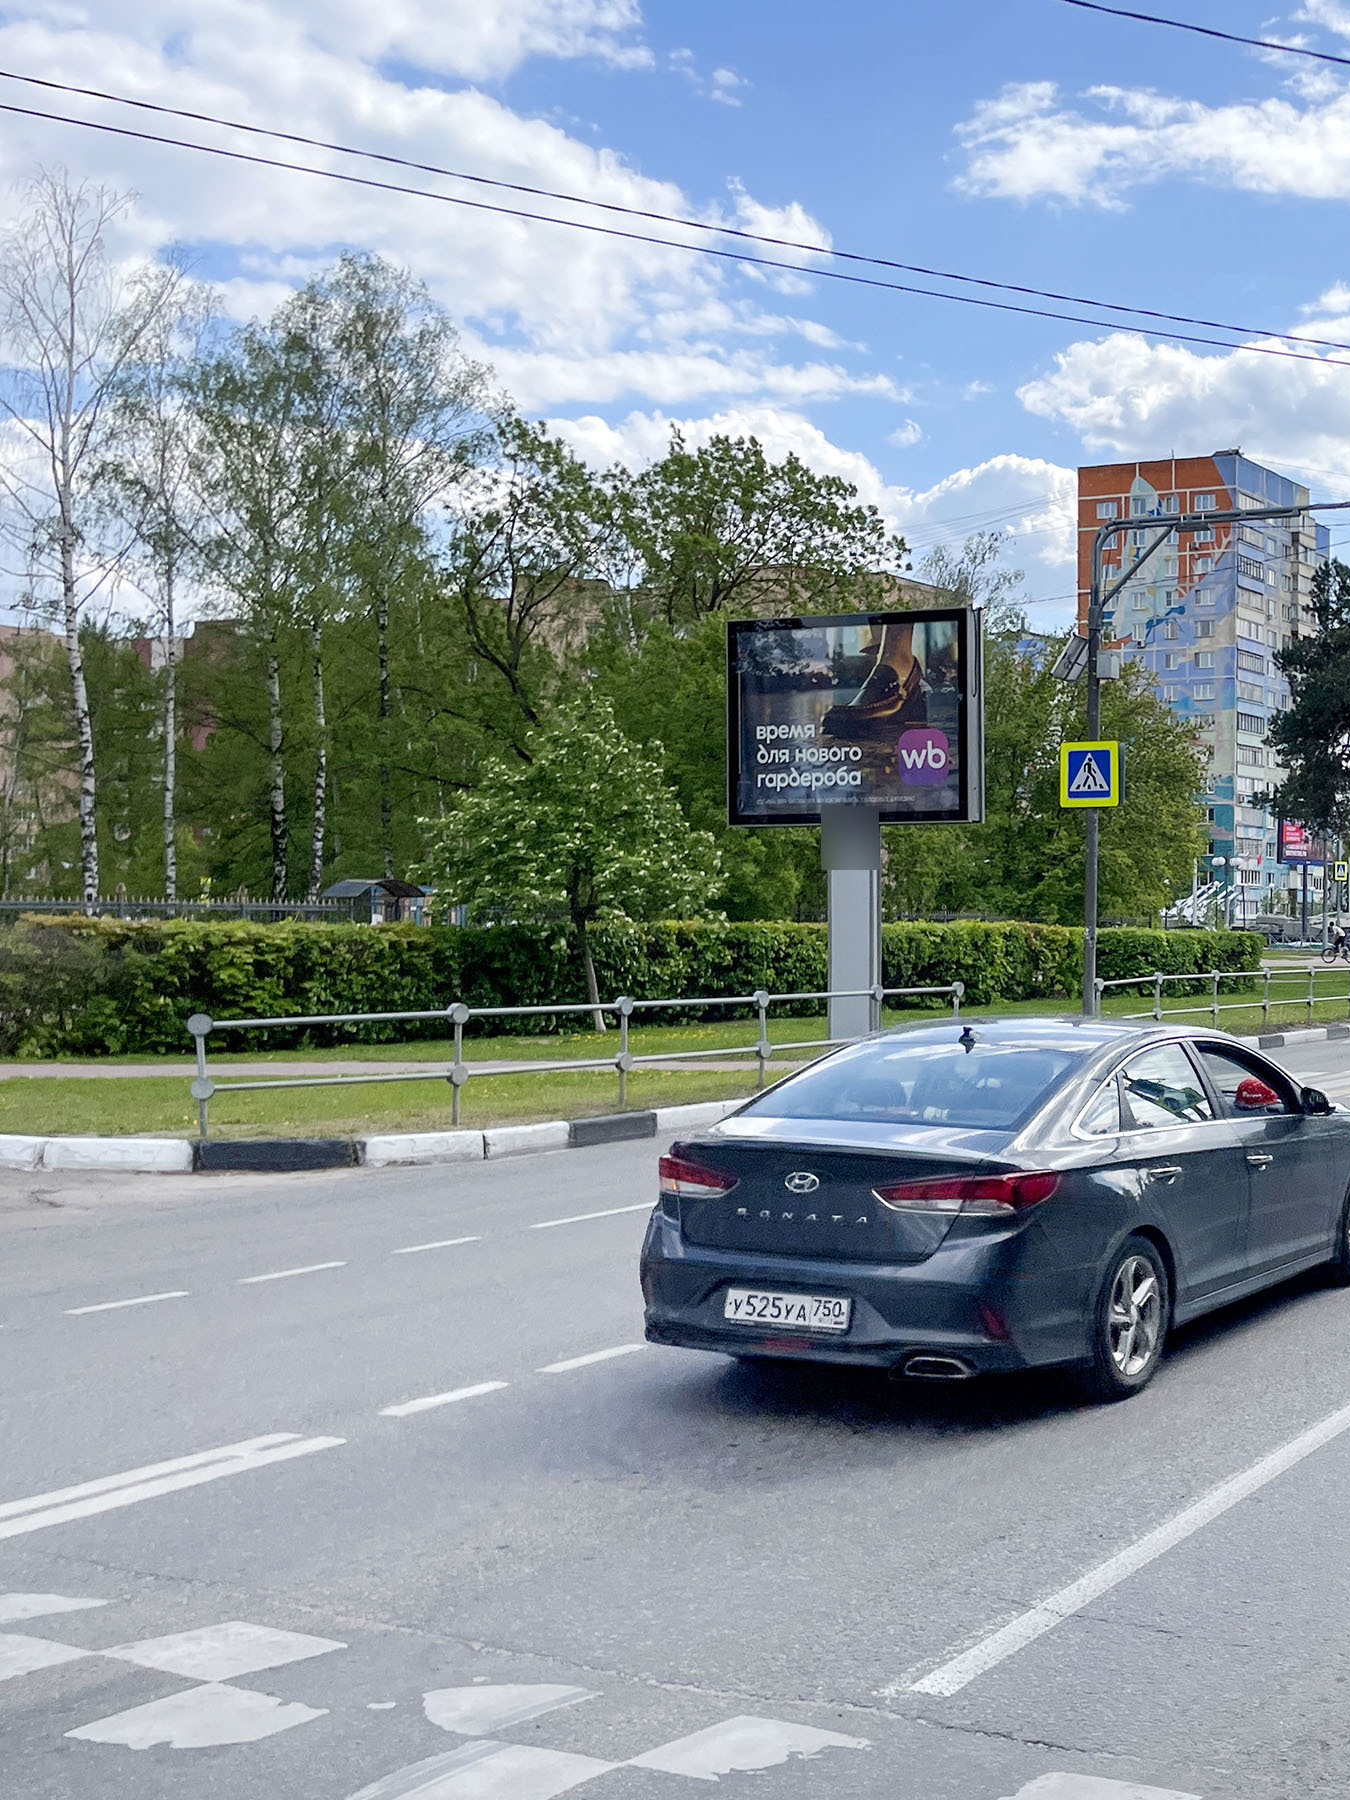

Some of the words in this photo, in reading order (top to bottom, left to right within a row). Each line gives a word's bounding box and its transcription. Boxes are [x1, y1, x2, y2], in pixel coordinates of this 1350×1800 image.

[756, 724, 815, 744] время
[757, 744, 789, 764] для
[795, 746, 862, 762] нового
[901, 740, 946, 769] wb
[757, 766, 861, 792] гардероба
[737, 1207, 867, 1223] SONATA
[813, 1299, 842, 1318] 750
